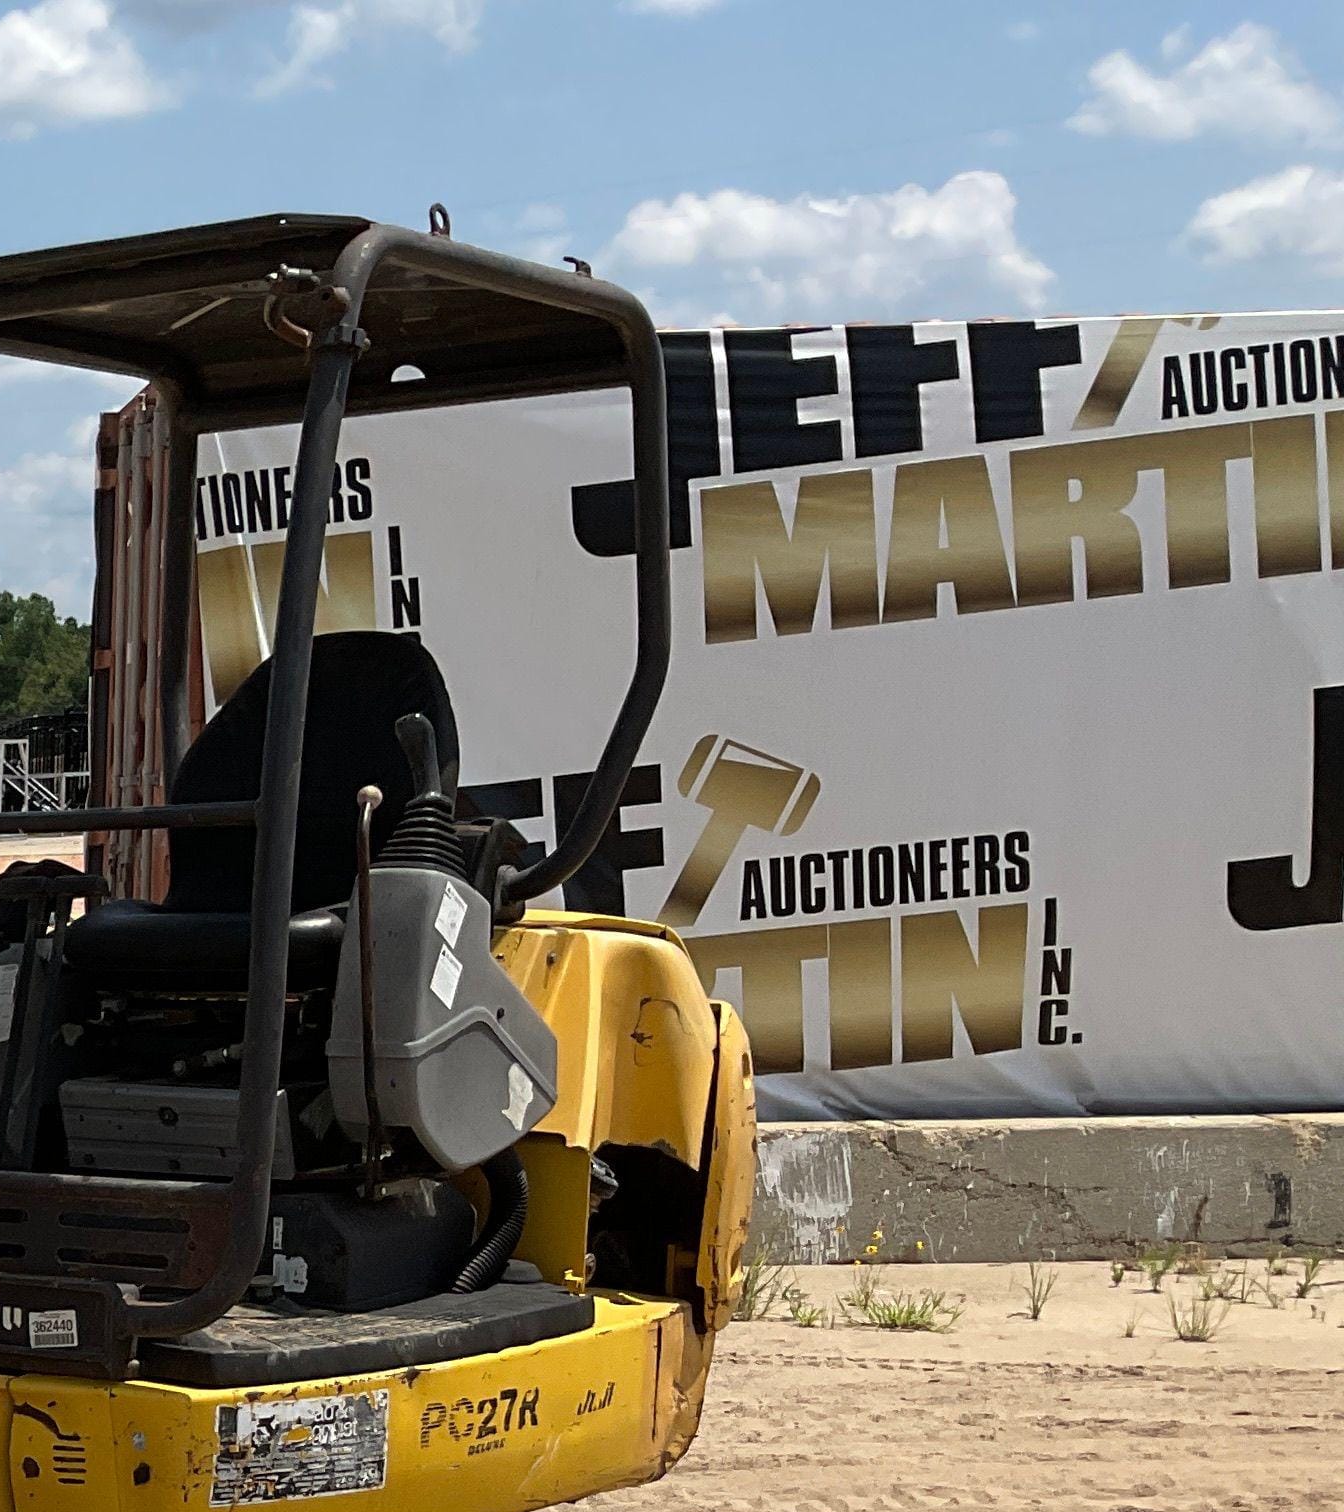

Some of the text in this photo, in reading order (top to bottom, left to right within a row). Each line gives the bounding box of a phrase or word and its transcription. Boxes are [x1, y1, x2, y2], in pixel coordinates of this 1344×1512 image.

[740, 831, 1030, 921] AUCTIONEERS
[1038, 898, 1082, 1046] INC.
[32, 1319, 73, 1333] 362440
